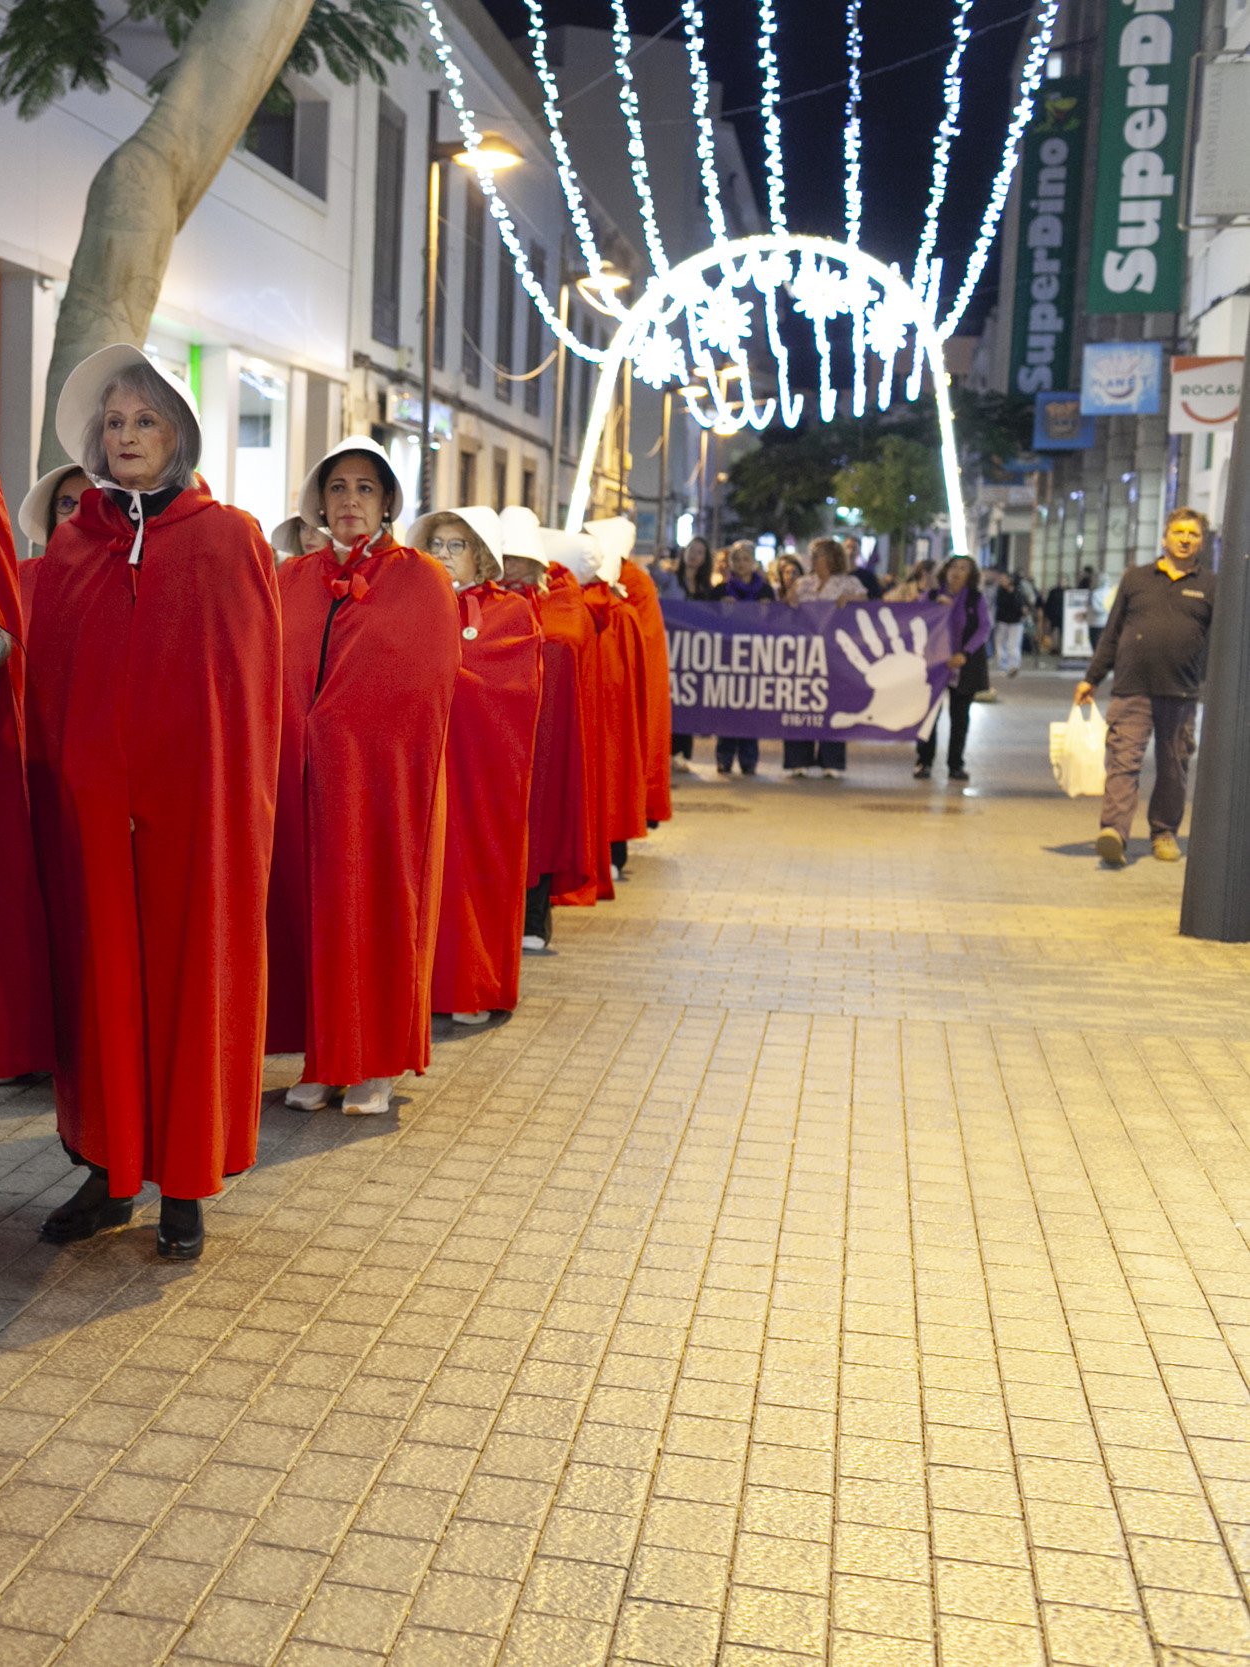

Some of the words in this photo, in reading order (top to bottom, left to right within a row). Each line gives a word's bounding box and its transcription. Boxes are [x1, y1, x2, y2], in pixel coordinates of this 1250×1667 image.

[1017, 137, 1069, 394] SuperDino
[665, 629, 829, 677] VIOLENCIA
[702, 673, 829, 713] MUJERES
